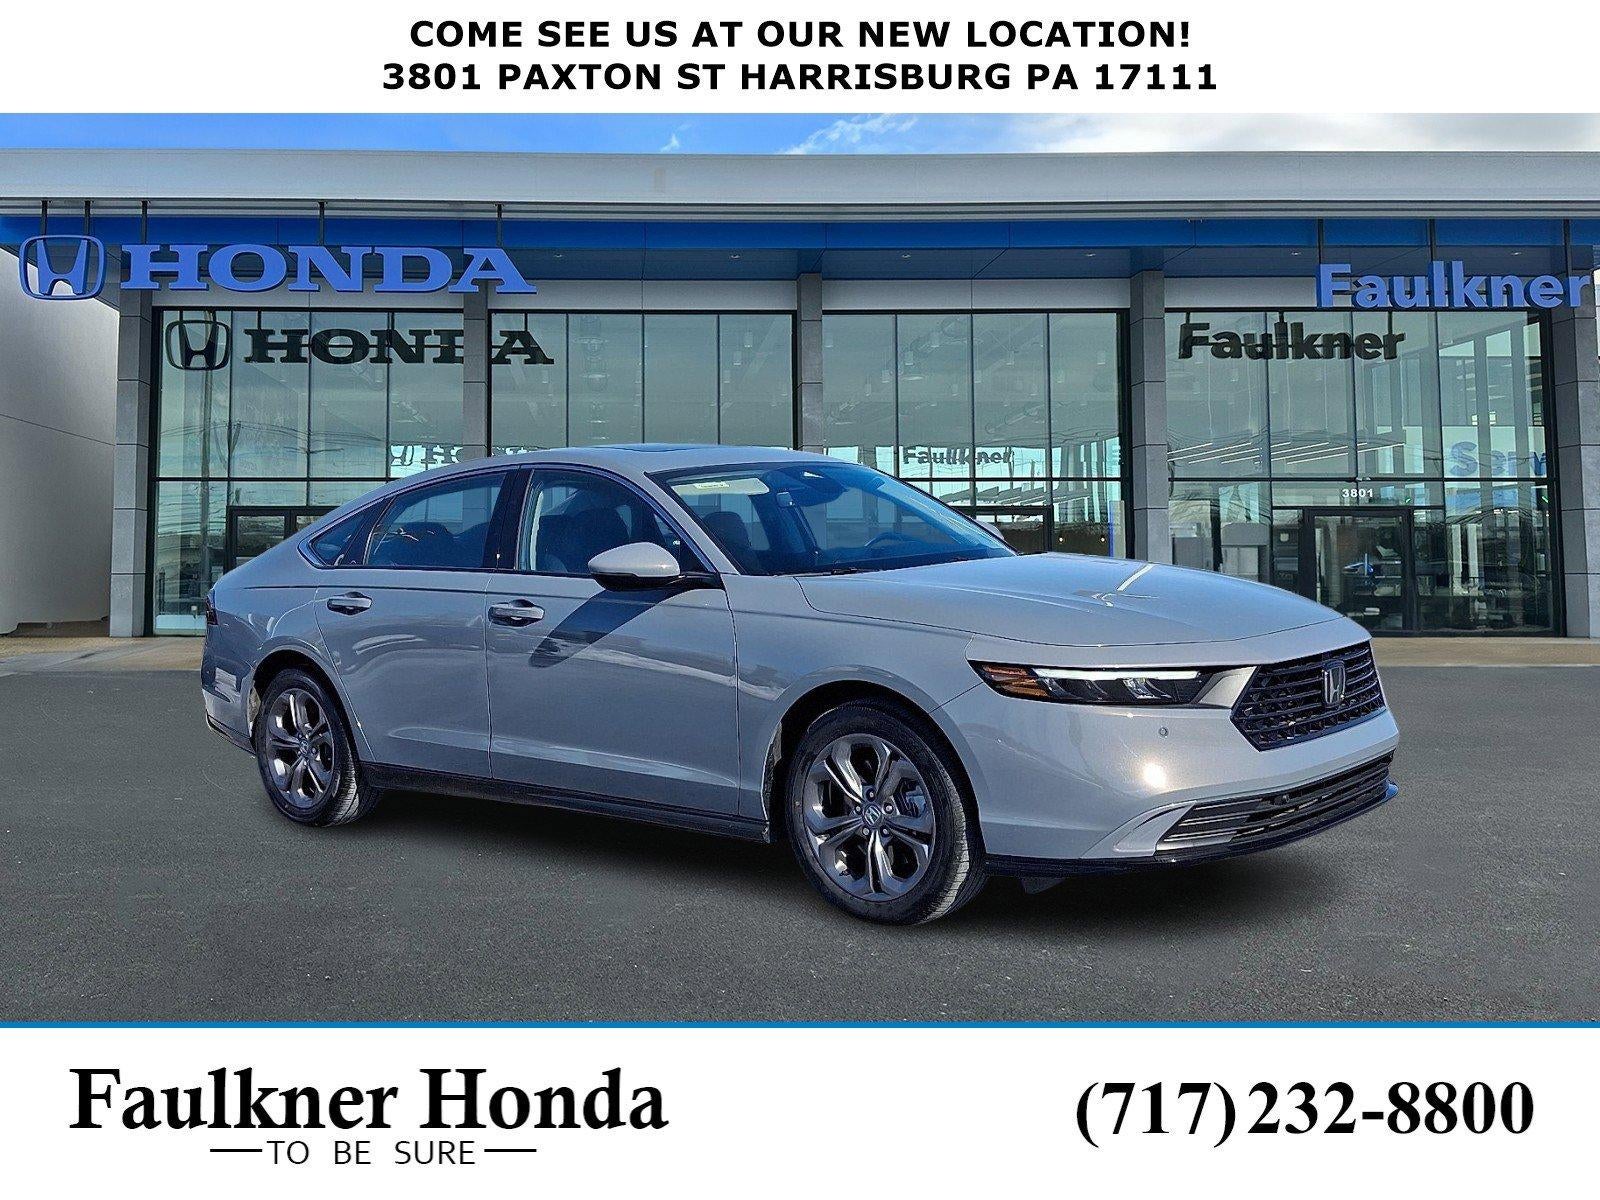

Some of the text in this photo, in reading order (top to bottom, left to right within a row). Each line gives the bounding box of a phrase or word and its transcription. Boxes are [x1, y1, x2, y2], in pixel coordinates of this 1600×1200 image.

[120, 243, 538, 294] HONDA
[1317, 260, 1591, 309] Faulkner
[1178, 322, 1406, 360] Faulkner
[1341, 488, 1373, 498] 3801
